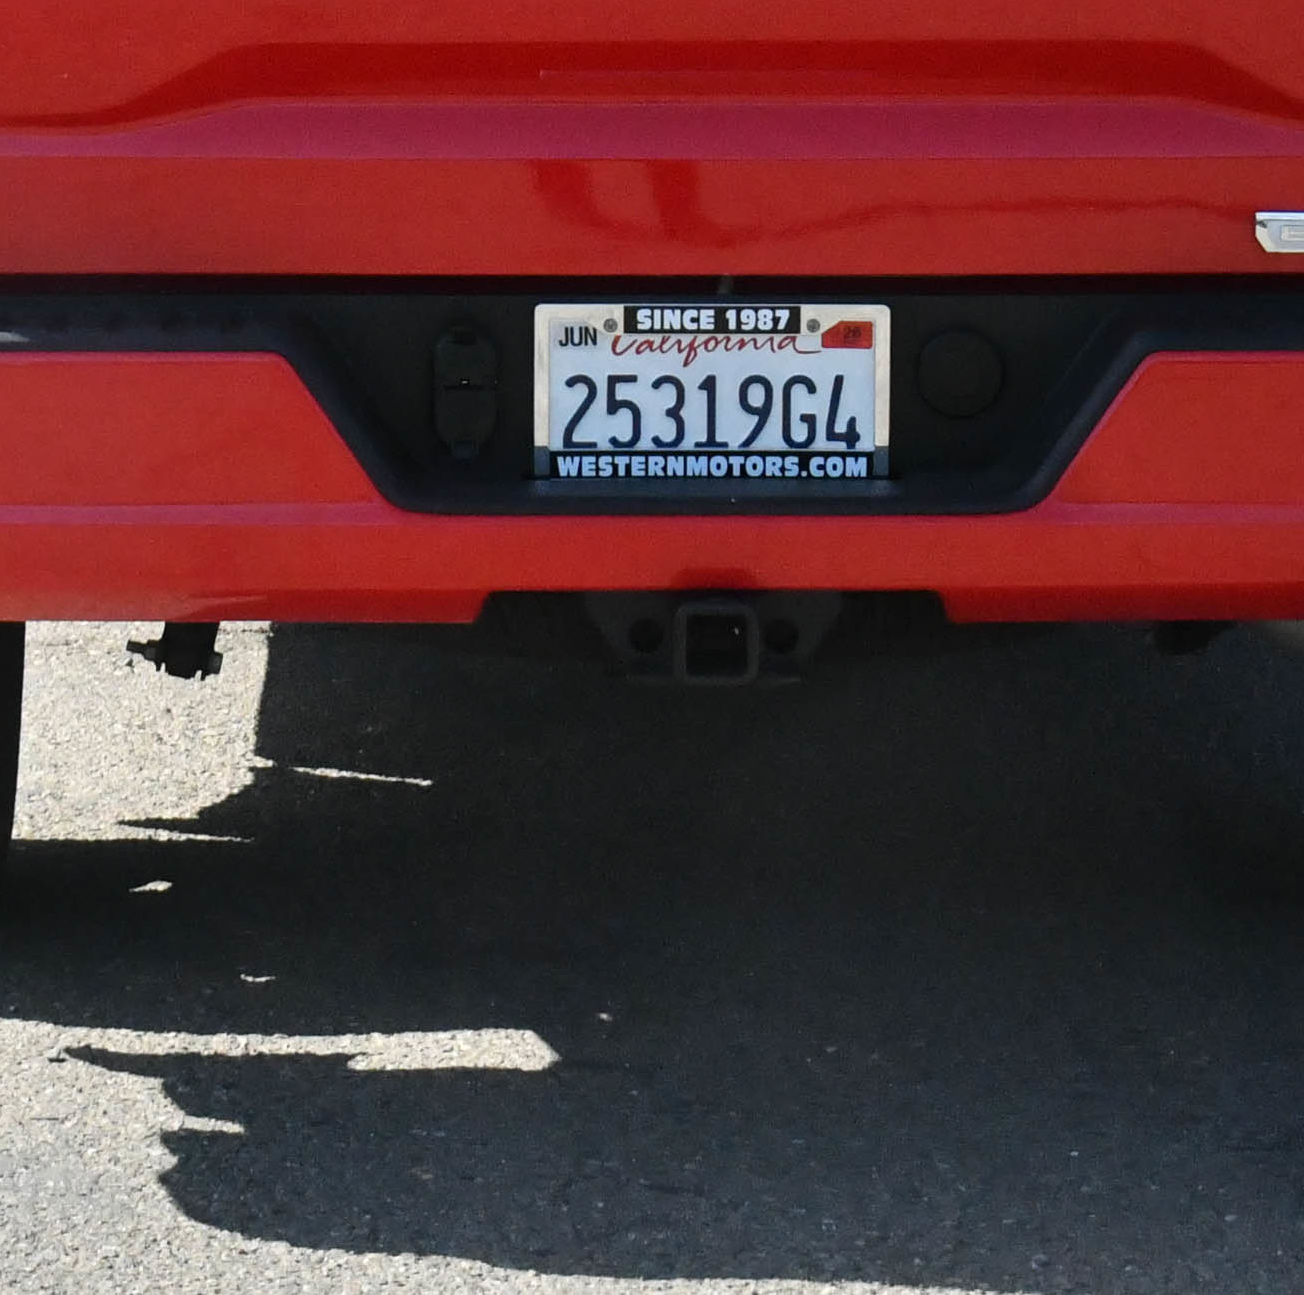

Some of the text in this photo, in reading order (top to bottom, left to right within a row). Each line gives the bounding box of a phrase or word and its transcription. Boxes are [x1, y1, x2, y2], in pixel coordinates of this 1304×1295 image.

[636, 308, 790, 330] SINCE 1987
[558, 326, 598, 347] JUN
[611, 335, 822, 368] California
[562, 373, 862, 450] 25319G4
[556, 455, 868, 478] WESTERNMOTORS.COM
